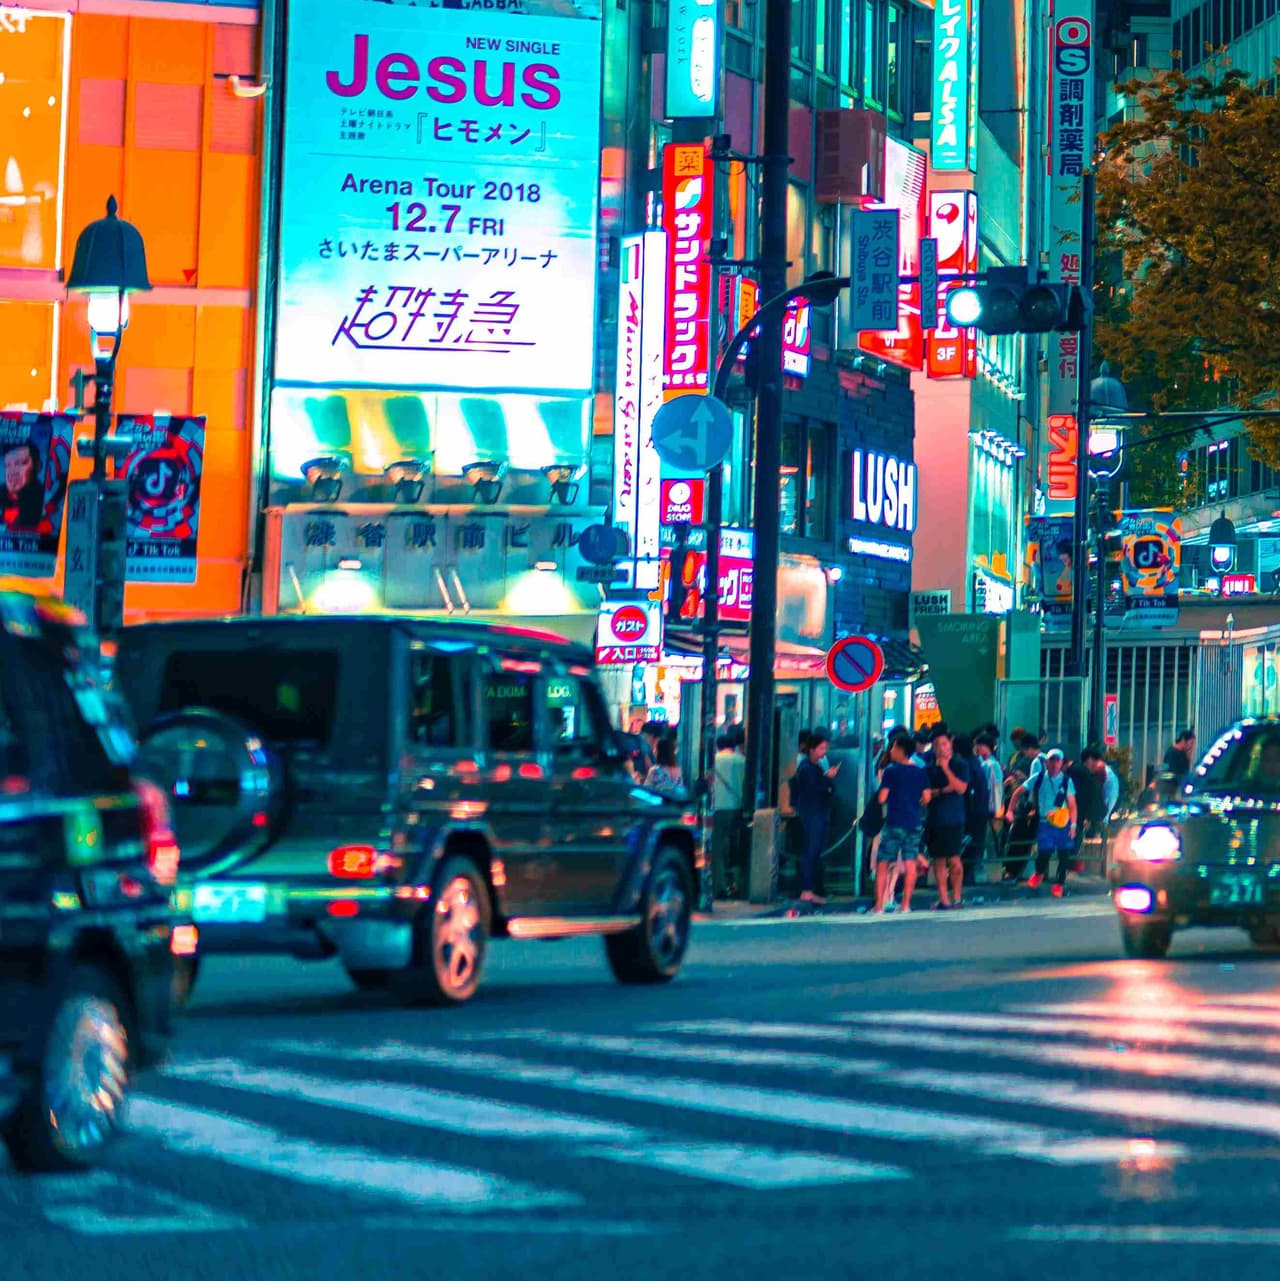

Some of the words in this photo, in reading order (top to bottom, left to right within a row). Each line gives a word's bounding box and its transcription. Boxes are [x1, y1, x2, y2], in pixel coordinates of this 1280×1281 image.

[465, 36, 501, 52] NEW
[504, 38, 561, 56] SINGLE
[675, 26, 689, 65] york
[325, 33, 562, 111] Jesus
[1058, 79, 1085, 177] 調剤薬局
[340, 172, 414, 197] Arena
[423, 177, 476, 200] Tour
[484, 181, 541, 203] 2018
[385, 201, 463, 234] 12.7
[468, 216, 505, 237] FRI
[317, 237, 560, 269] さいたまスーパーアリーナ
[857, 235, 870, 282] Shibuya
[871, 219, 894, 322] 渋谷駅前
[672, 212, 701, 371] サンドラッグ
[331, 284, 537, 354] 超特急
[936, 347, 956, 361] 3F
[852, 448, 915, 532] LUSH
[914, 594, 949, 605] LUSH
[614, 616, 645, 632] ガスト
[612, 646, 637, 660] 入口
